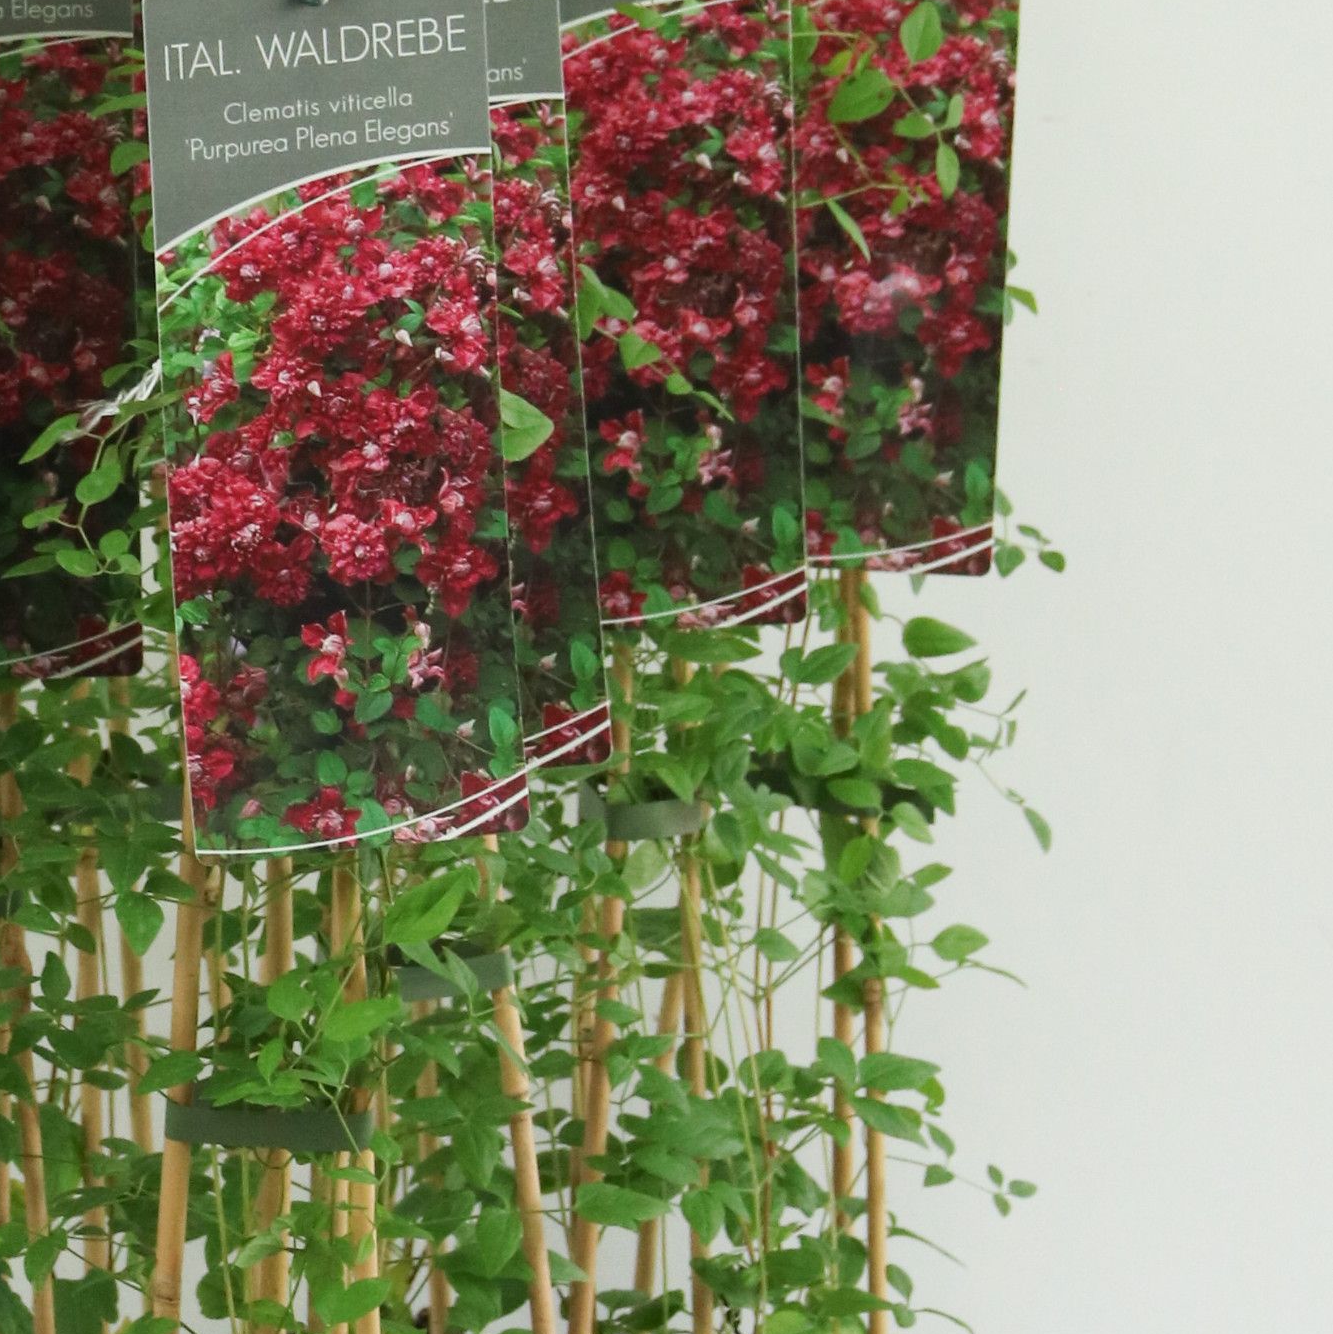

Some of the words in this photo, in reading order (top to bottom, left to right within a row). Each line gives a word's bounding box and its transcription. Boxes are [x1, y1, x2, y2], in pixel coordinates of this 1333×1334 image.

[164, 38, 241, 81] ITAL.
[255, 14, 467, 70] WALDREBE
[224, 101, 320, 125] Clematis
[328, 86, 413, 113] viticella
[185, 136, 288, 163] 'Purpurea
[296, 125, 357, 149] Plena
[365, 111, 454, 145] Elegans'
